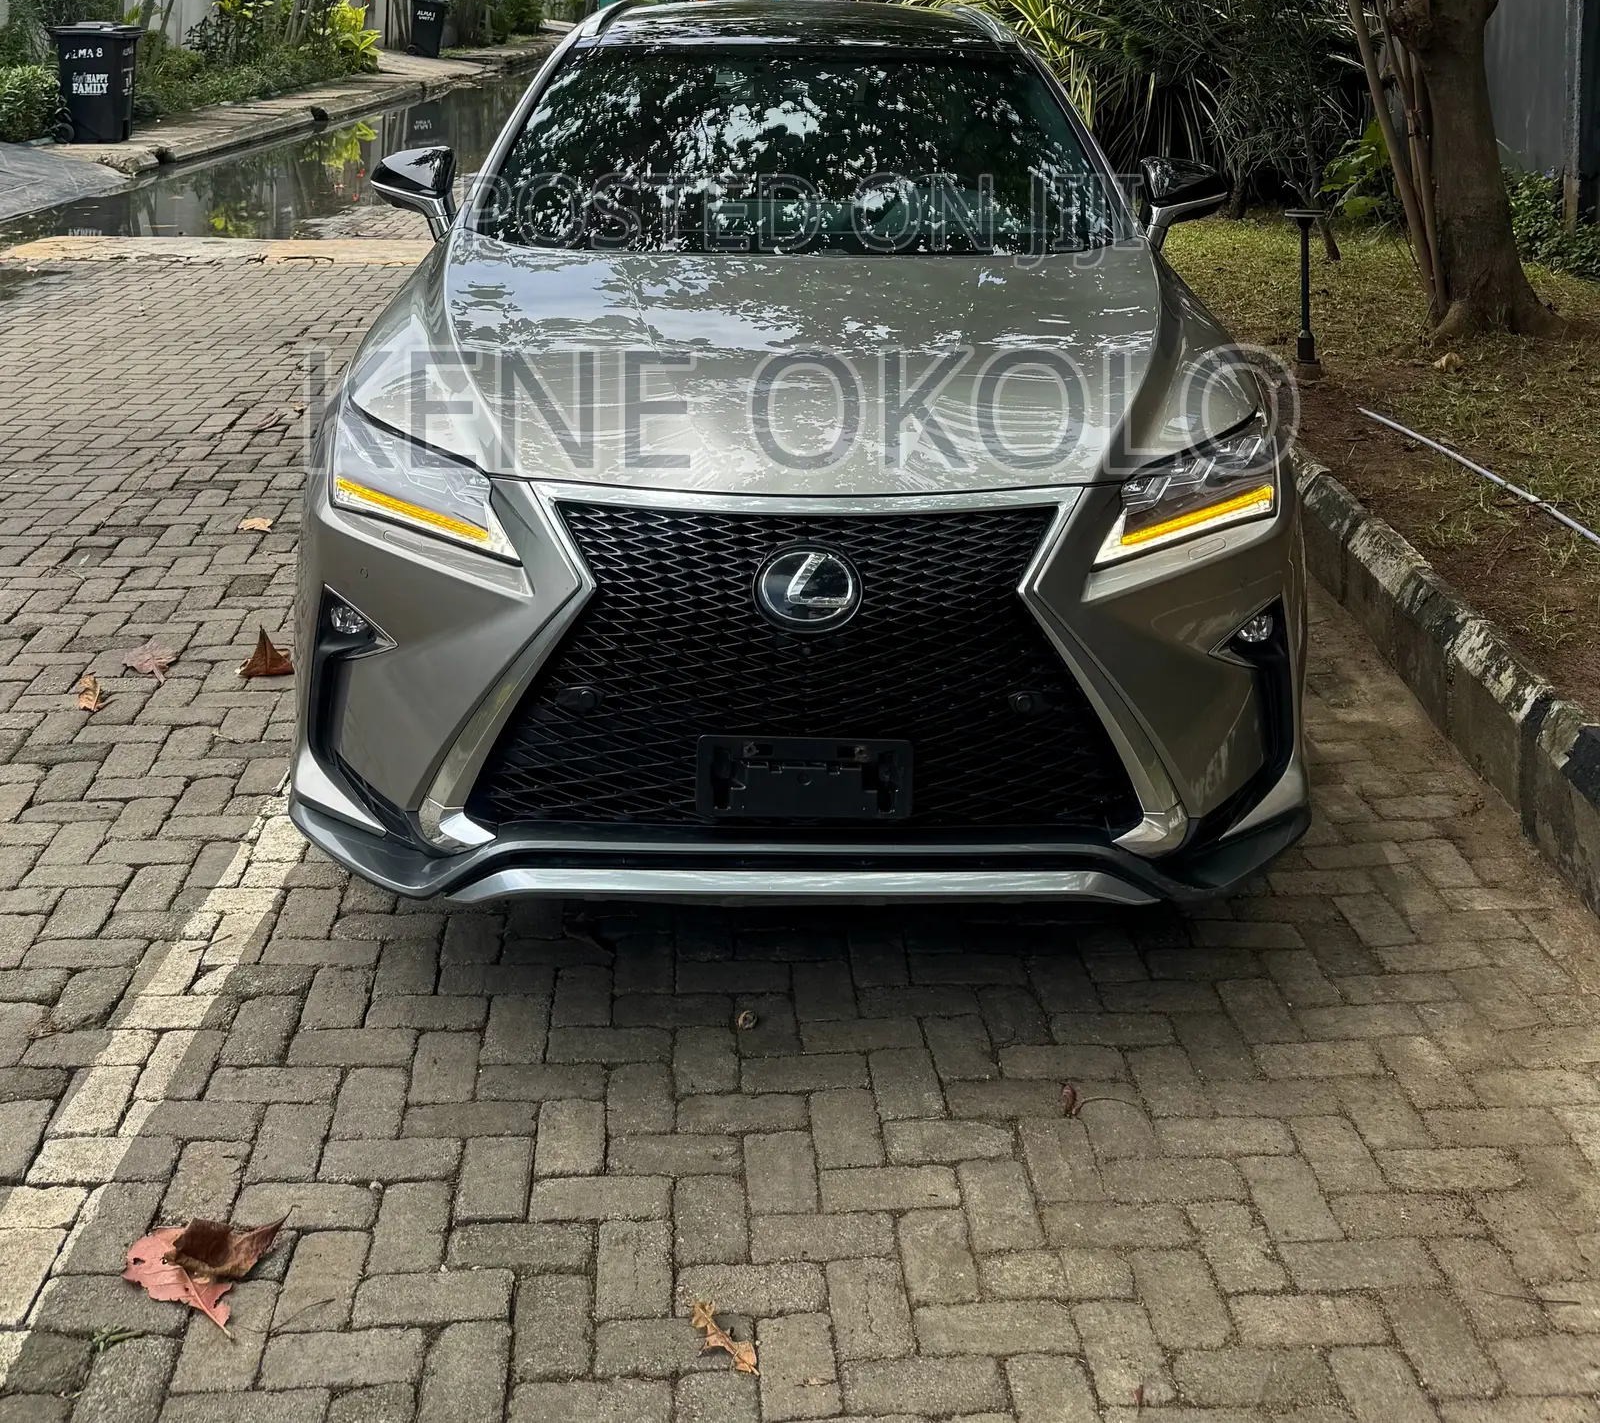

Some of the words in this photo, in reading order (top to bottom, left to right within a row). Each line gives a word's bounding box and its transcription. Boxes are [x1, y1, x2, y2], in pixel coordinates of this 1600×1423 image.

[96, 47, 103, 58] 8
[86, 73, 109, 83] HAPPY
[72, 83, 109, 94] FAMILY
